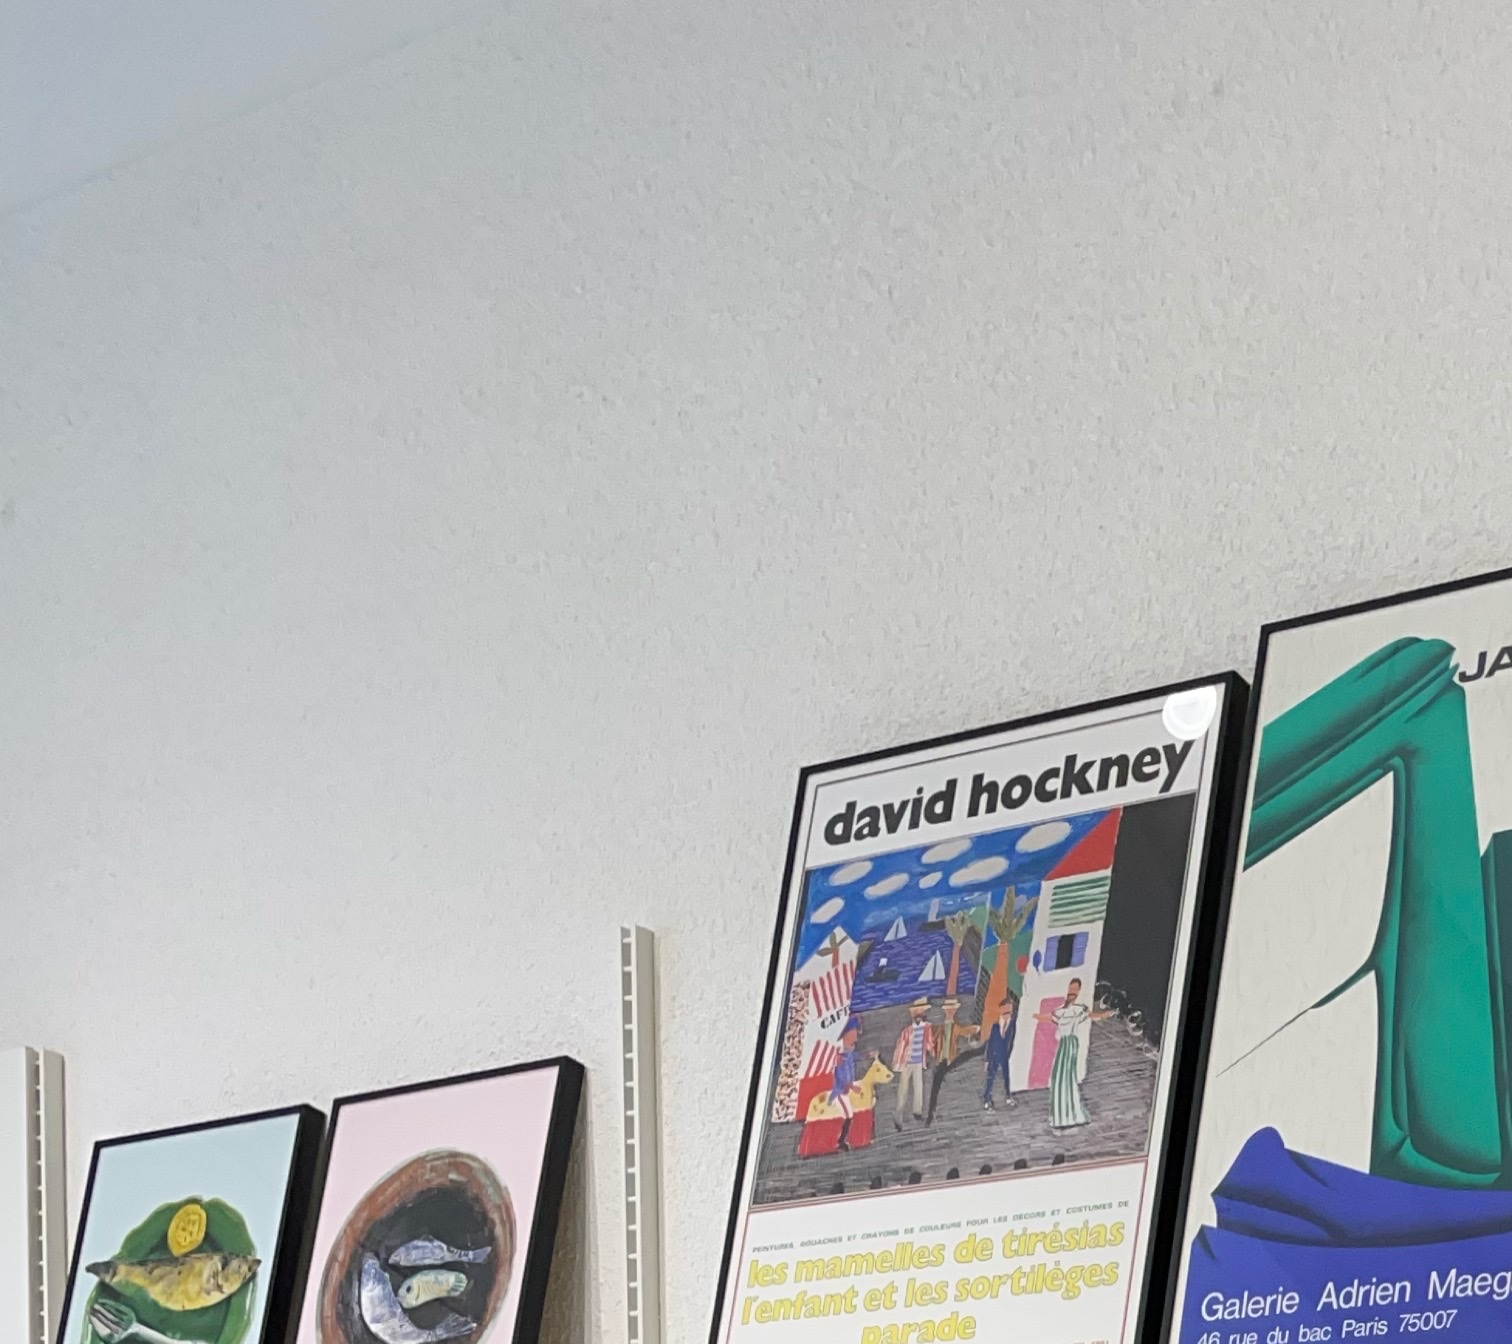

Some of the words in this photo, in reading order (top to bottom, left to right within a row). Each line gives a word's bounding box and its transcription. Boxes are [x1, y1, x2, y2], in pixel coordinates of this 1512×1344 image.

[824, 778, 958, 846] david
[967, 739, 1195, 818] hockney
[747, 1259, 788, 1288] les
[794, 1241, 946, 1283] mamelles
[954, 1233, 995, 1263] de
[1002, 1219, 1125, 1260] tirésias
[741, 1285, 858, 1325] l'enfant
[864, 1284, 897, 1312] et
[904, 1275, 949, 1308] les
[955, 1260, 1120, 1301] sortilèges
[1201, 1286, 1300, 1322] Galerie
[1318, 1276, 1412, 1312] Adrien
[1297, 1321, 1332, 1343] bac
[1340, 1315, 1388, 1339] Paris
[1398, 1310, 1458, 1335] 75007
